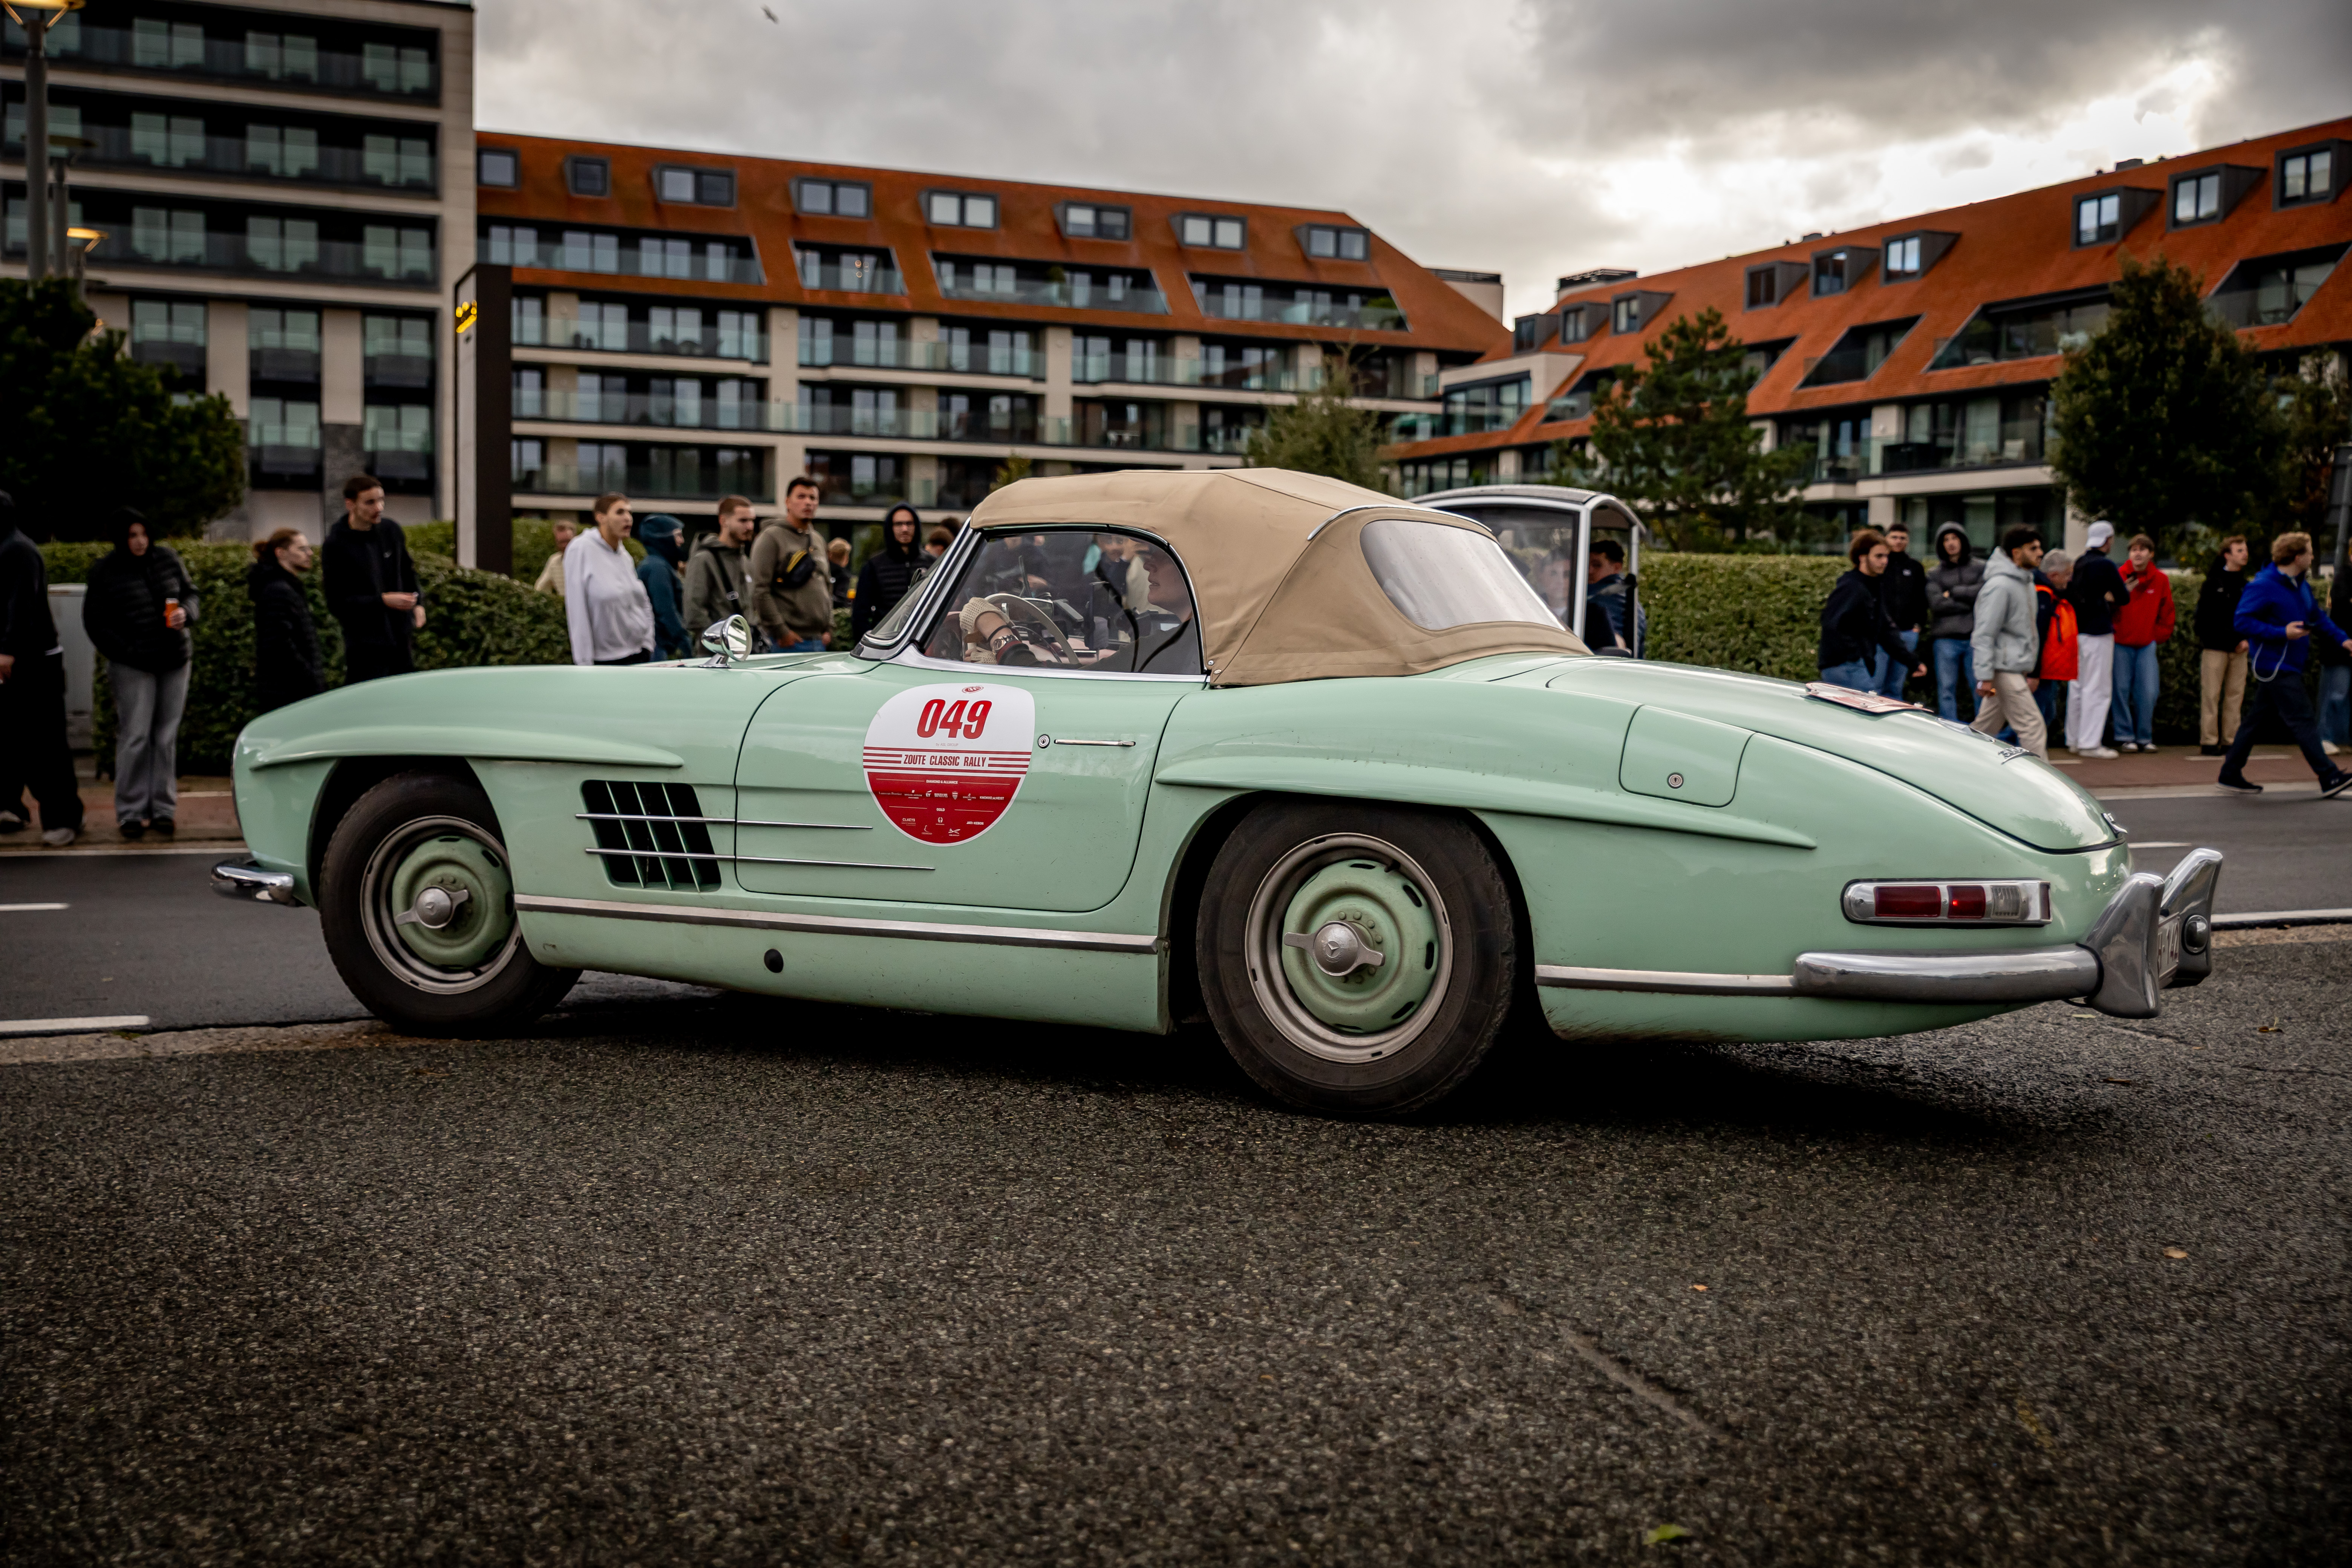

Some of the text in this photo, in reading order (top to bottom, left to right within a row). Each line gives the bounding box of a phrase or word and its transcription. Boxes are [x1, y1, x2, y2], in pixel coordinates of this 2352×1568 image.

[917, 699, 992, 739] 049
[903, 755, 986, 767] ZOUTE CLASSIC RALLY
